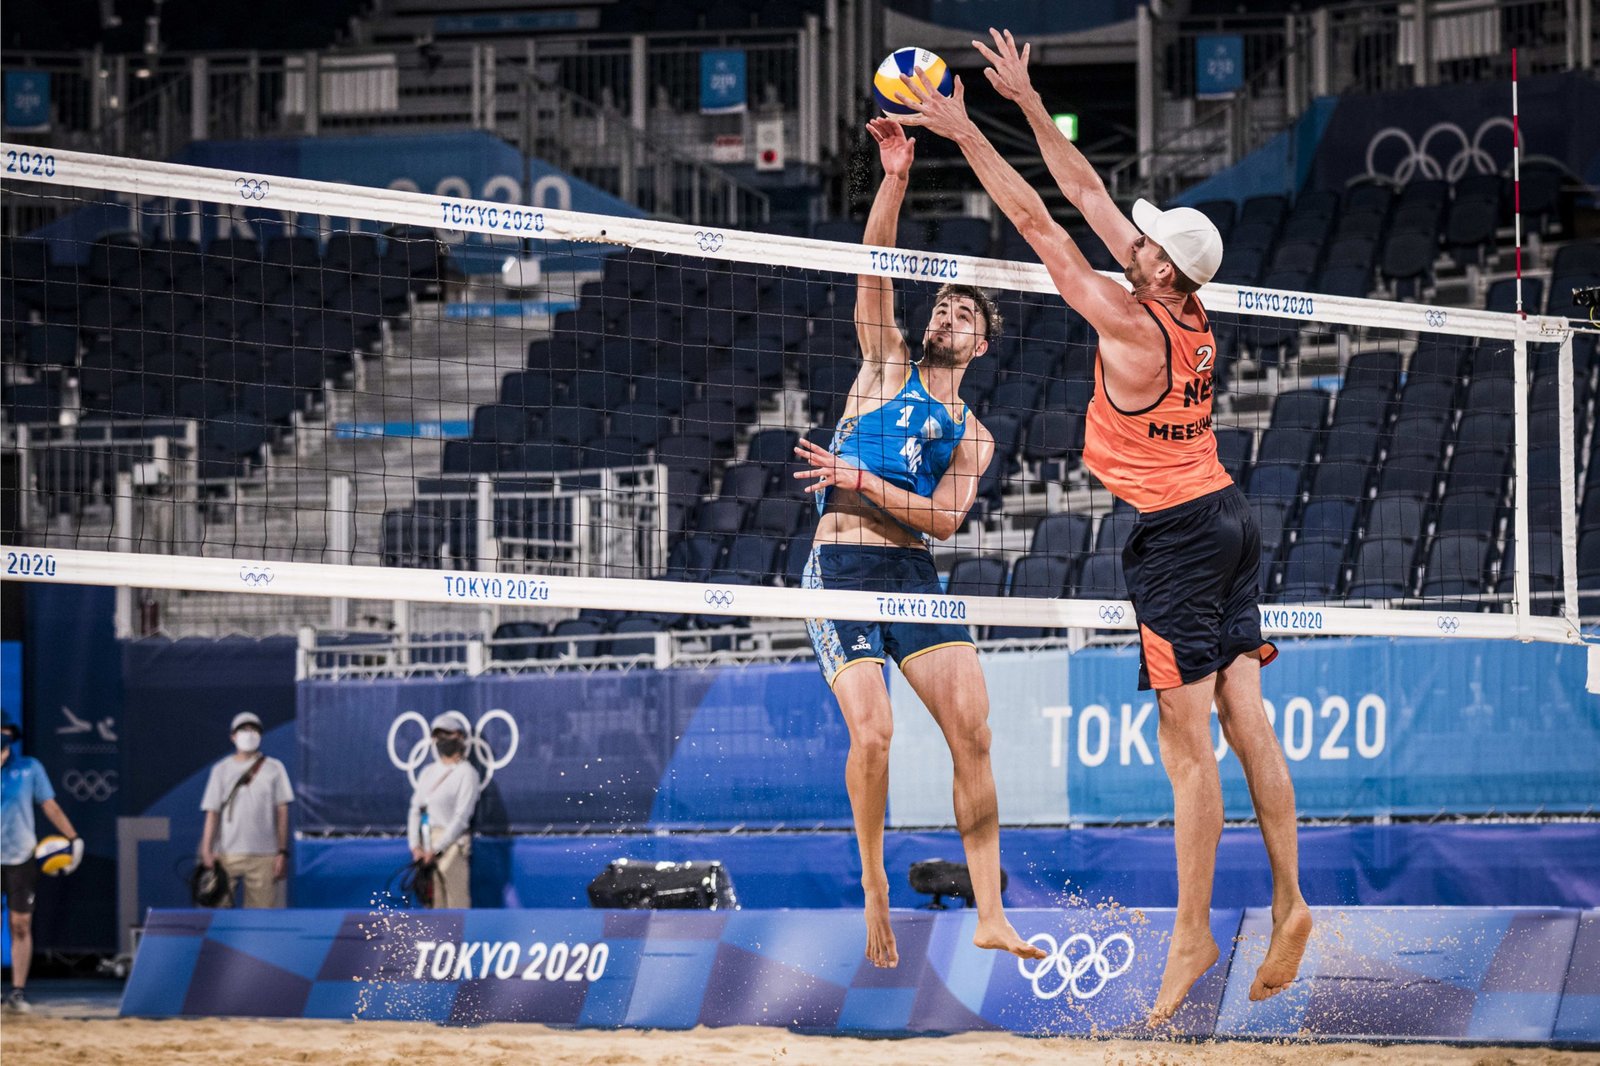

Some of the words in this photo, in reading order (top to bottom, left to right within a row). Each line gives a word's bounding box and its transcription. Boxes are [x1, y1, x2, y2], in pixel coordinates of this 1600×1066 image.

[6, 150, 56, 178] 2020
[441, 202, 498, 228] TOKYO
[502, 209, 545, 232] 2020
[870, 250, 918, 274] TOKYO
[920, 256, 958, 279] 2020
[1237, 290, 1280, 311] TOKYO
[1282, 295, 1314, 315] 2020
[1195, 344, 1214, 373] 2
[1183, 377, 1213, 408] NE
[895, 405, 915, 428] 1
[7, 552, 56, 576] 2020
[443, 576, 502, 598] TOKYO
[506, 579, 549, 600] 2020
[876, 597, 927, 617] TOKYO
[930, 599, 966, 619] 2020
[1262, 610, 1289, 629] KYO
[1291, 610, 1323, 630] 2020
[1262, 693, 1386, 762] 020
[413, 940, 521, 981] TOKYO
[521, 941, 609, 982] 2020
